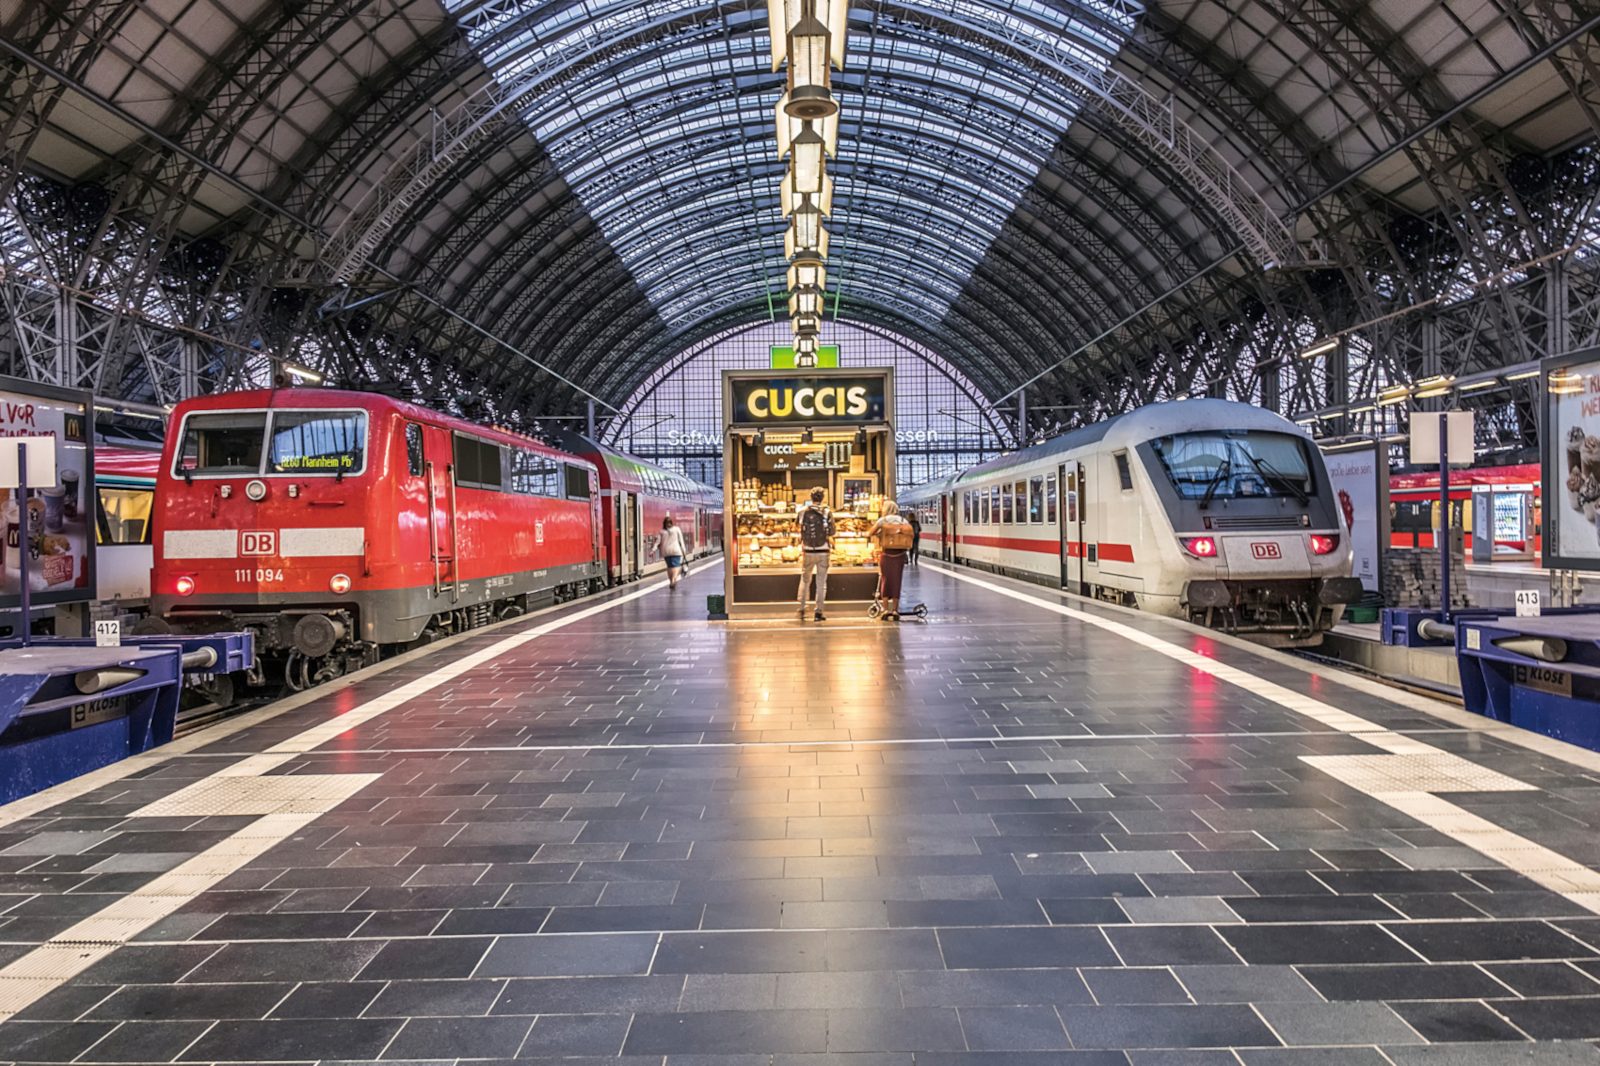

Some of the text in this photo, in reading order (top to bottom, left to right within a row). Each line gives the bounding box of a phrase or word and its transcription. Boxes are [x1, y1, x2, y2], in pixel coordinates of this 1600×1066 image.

[747, 386, 867, 418] CUCCIS
[1581, 397, 1600, 418] WE
[6, 402, 36, 428] VOR
[668, 429, 724, 446] Softw
[302, 455, 339, 468] Mannheim
[244, 534, 273, 552] DB
[1254, 545, 1278, 557] DB
[234, 568, 284, 583] 111 094
[1516, 592, 1538, 605] 413
[97, 622, 118, 635] 412
[1529, 666, 1565, 685] KLOSE
[88, 696, 121, 713] KLOSE
